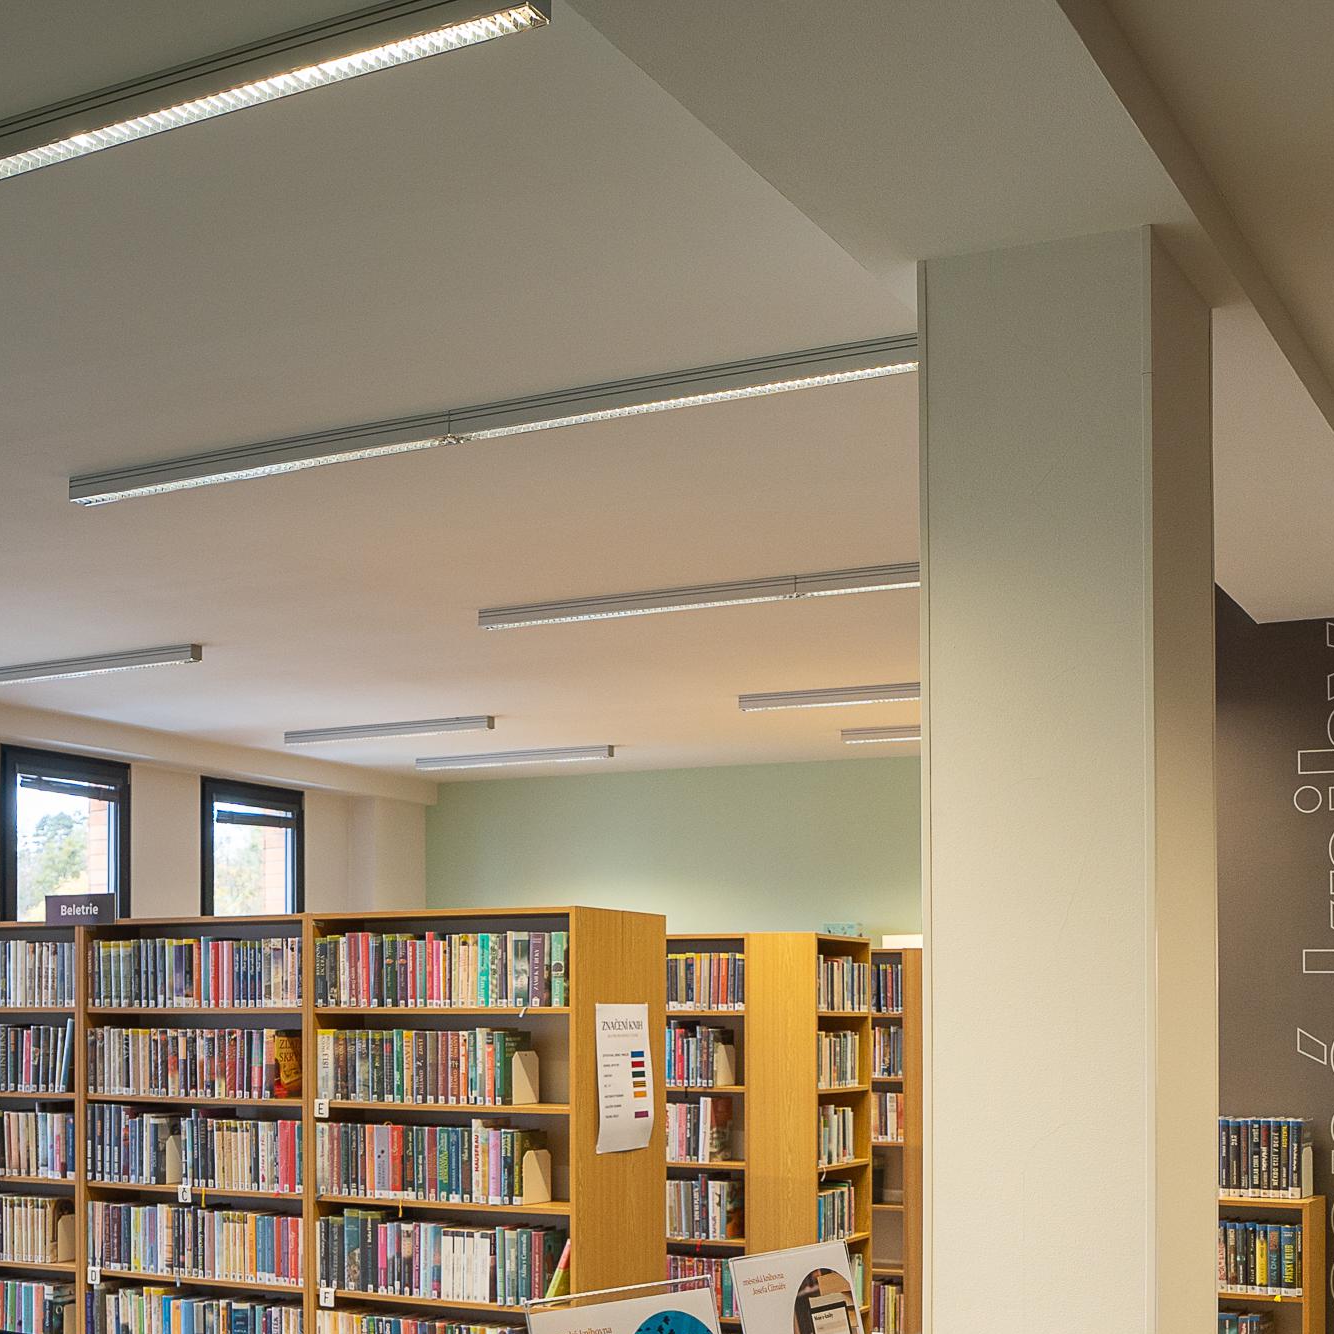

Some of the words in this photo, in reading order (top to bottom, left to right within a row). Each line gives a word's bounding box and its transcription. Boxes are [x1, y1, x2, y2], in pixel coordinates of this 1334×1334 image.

[60, 903, 99, 917] Beletrie
[318, 1103, 325, 1116] E
[324, 1292, 330, 1304] F
